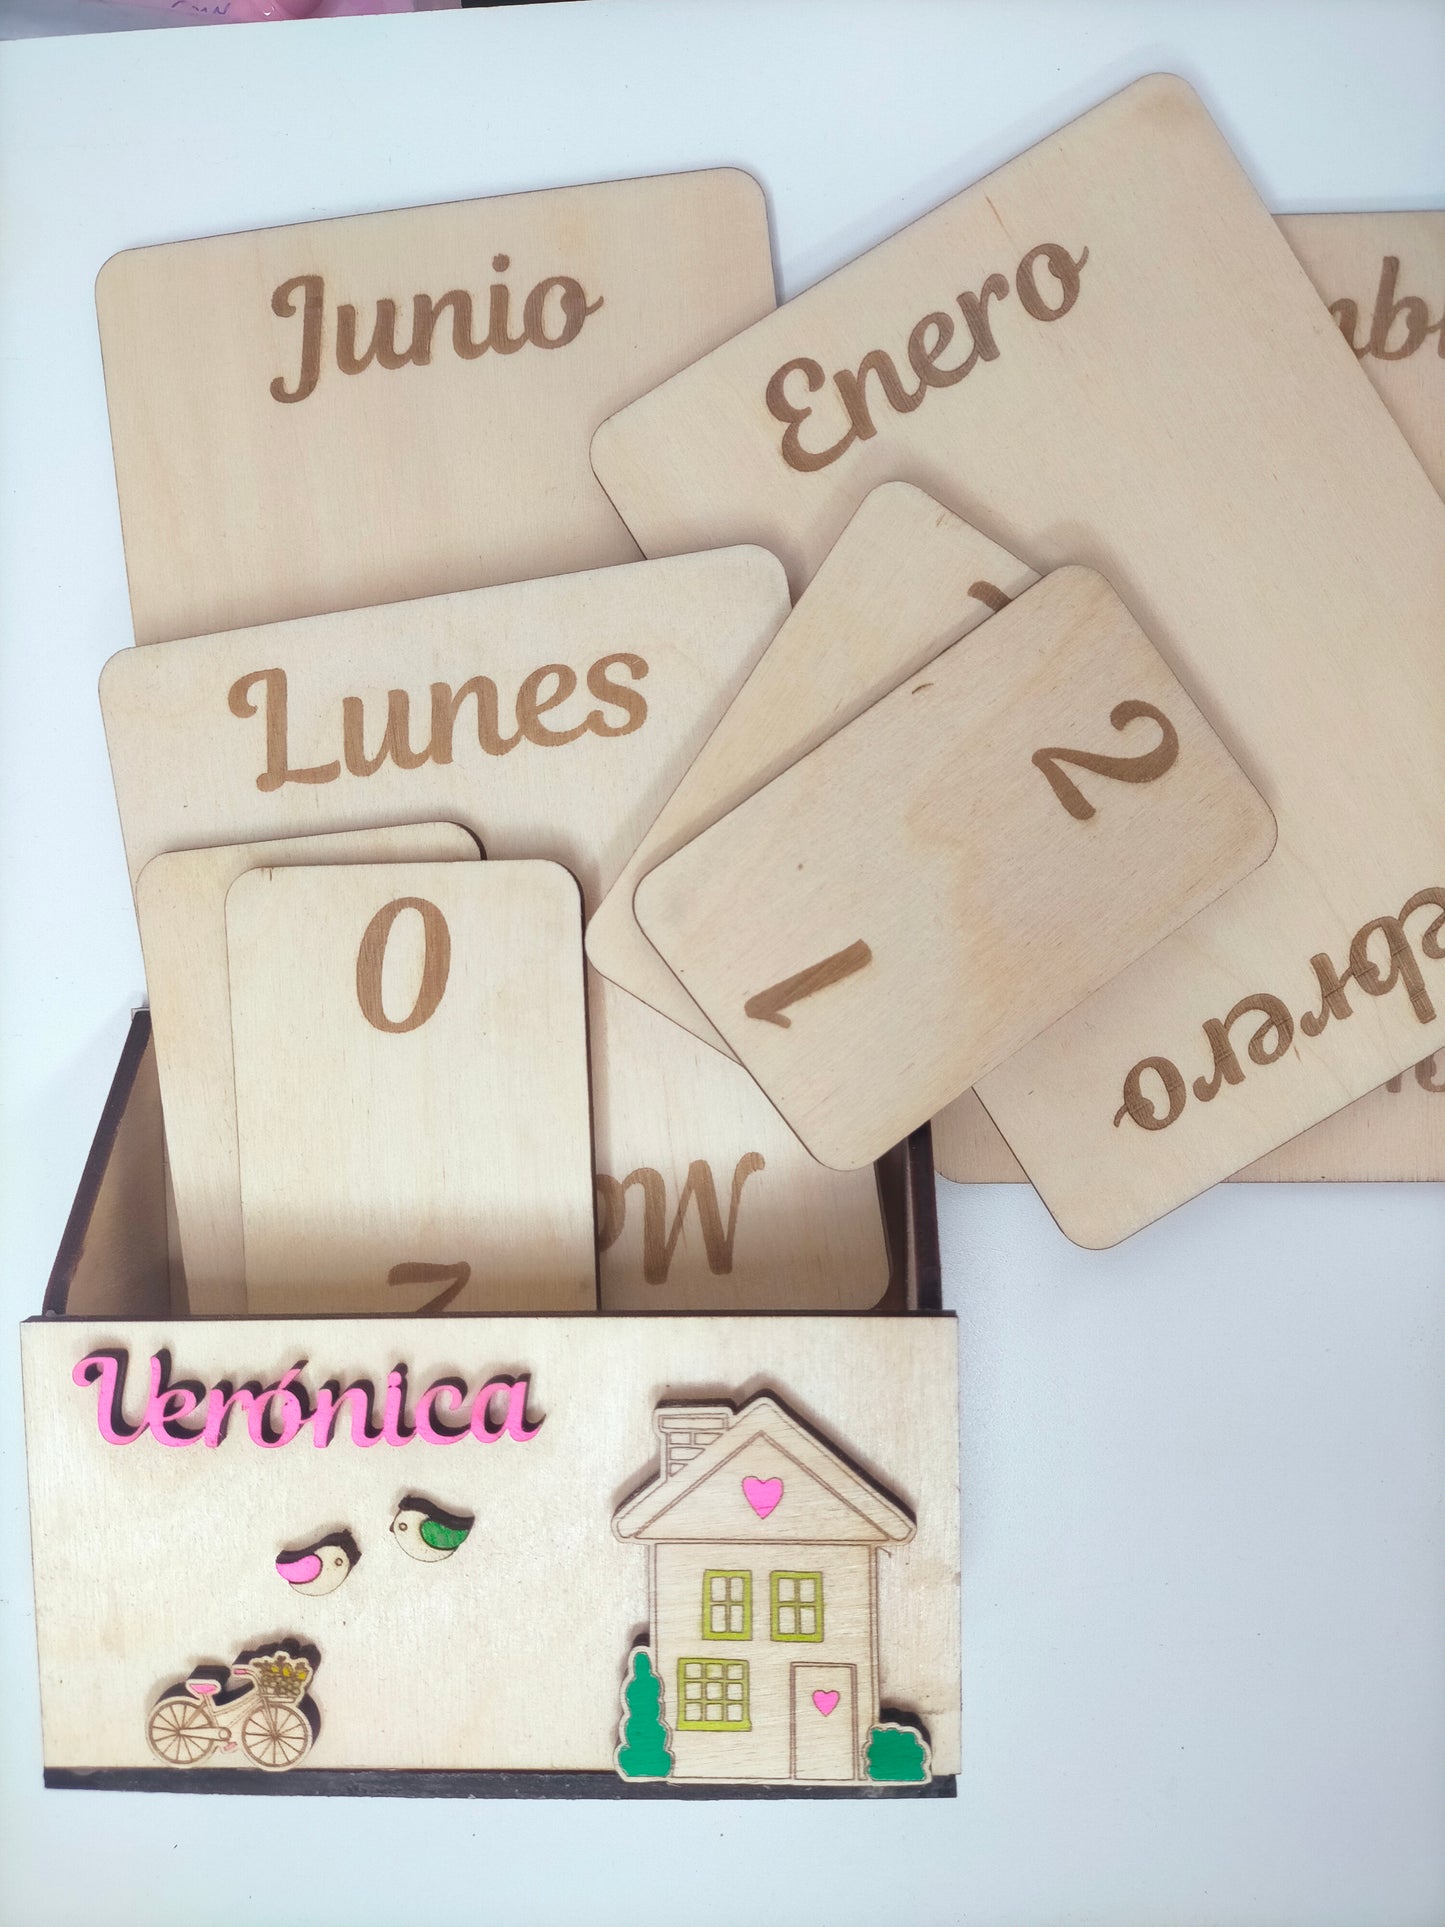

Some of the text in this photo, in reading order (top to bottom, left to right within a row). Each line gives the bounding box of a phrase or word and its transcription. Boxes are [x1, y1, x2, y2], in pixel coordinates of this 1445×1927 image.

[270, 253, 604, 404] Junio
[765, 243, 1090, 473] Enero
[228, 652, 649, 793] Lunes
[1032, 700, 1179, 820] 2
[72, 1350, 547, 1449] Verónica
